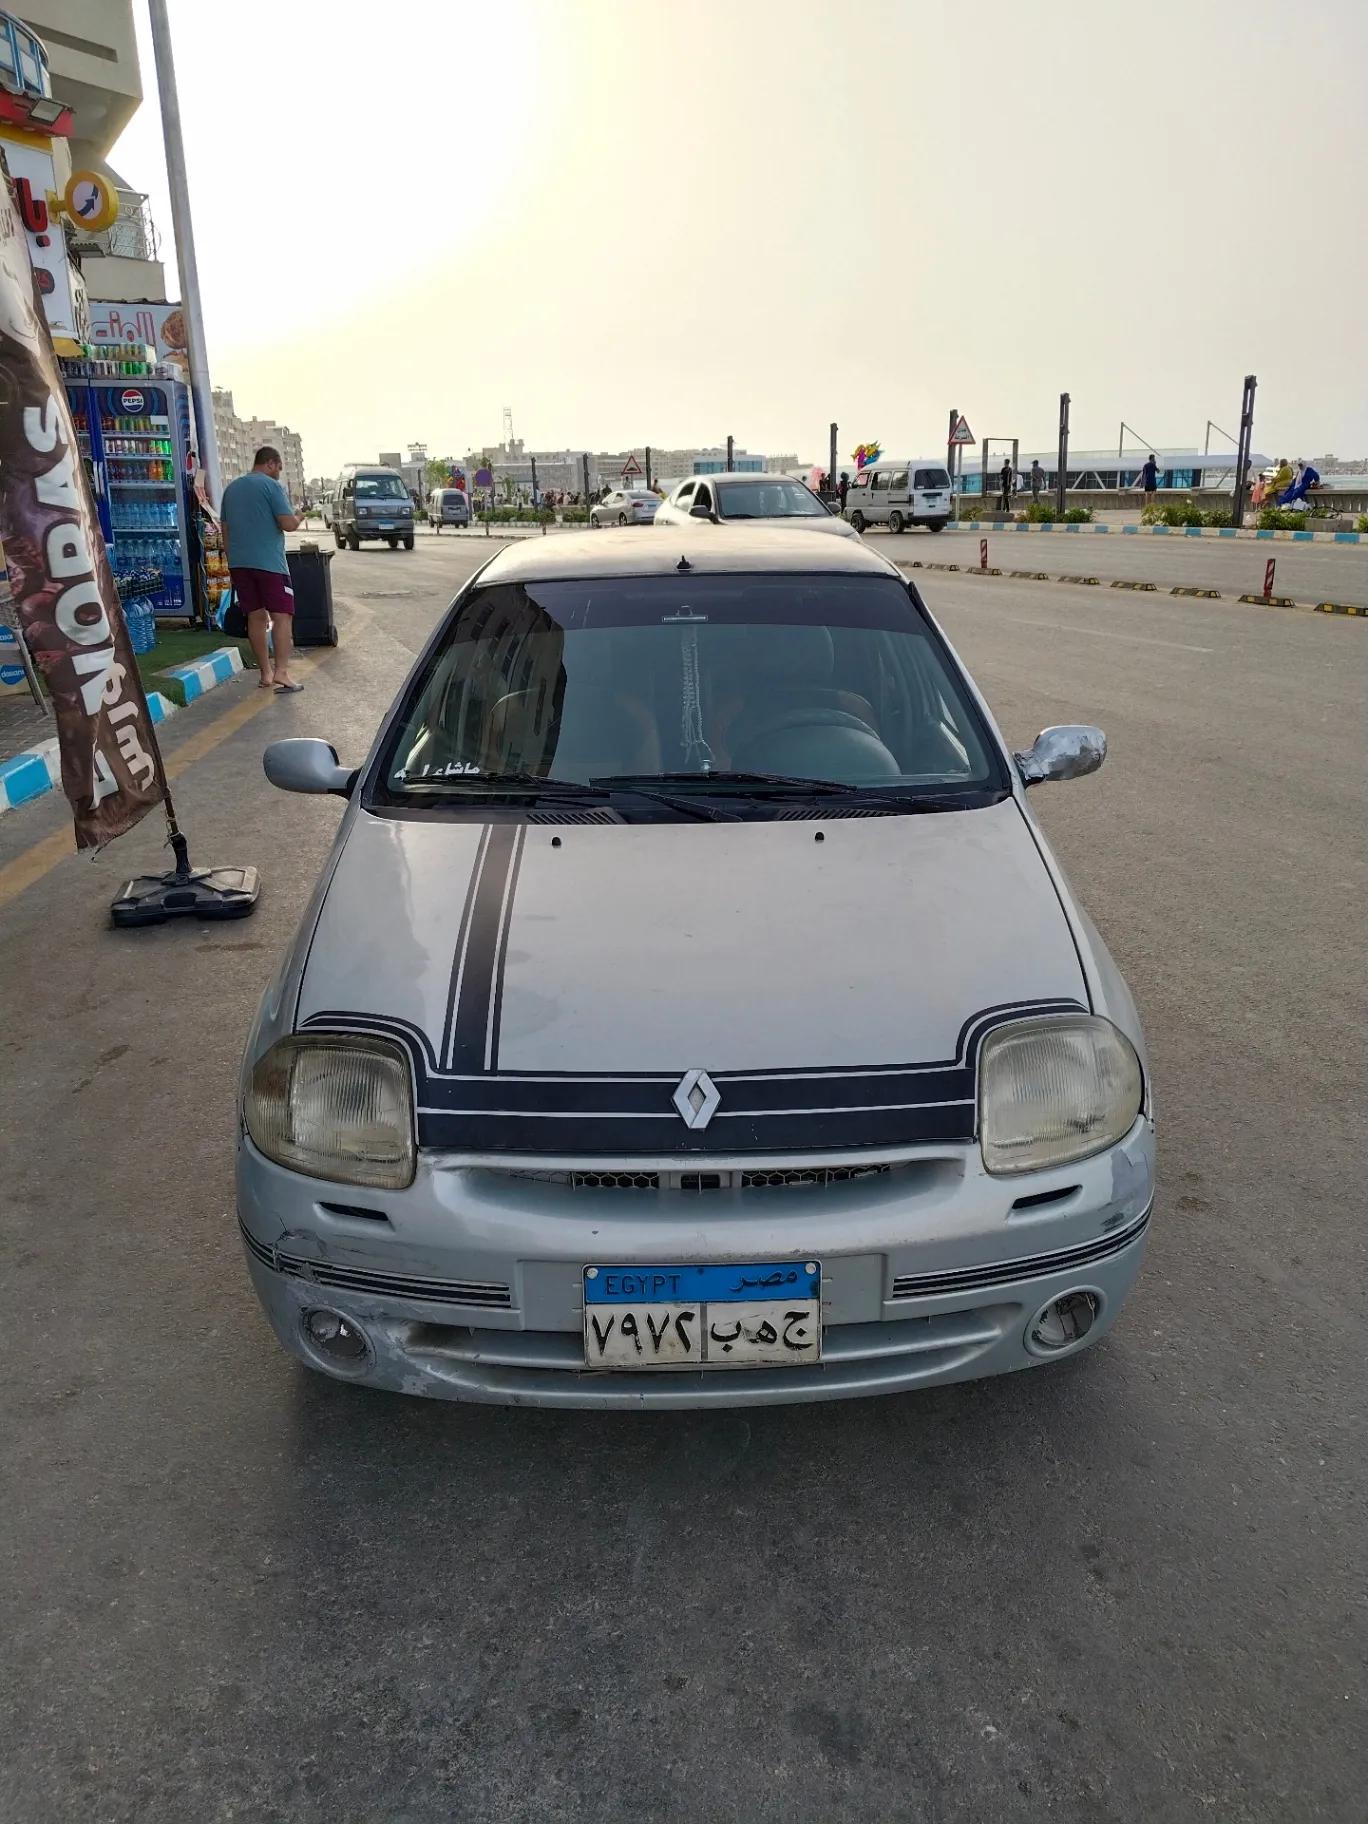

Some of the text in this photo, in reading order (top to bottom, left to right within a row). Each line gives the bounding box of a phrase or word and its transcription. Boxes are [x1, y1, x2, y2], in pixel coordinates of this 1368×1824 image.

[606, 1275, 681, 1296] EGYPT
[729, 1270, 798, 1293] مصر
[592, 1311, 695, 1356] ٧٩٧٢
